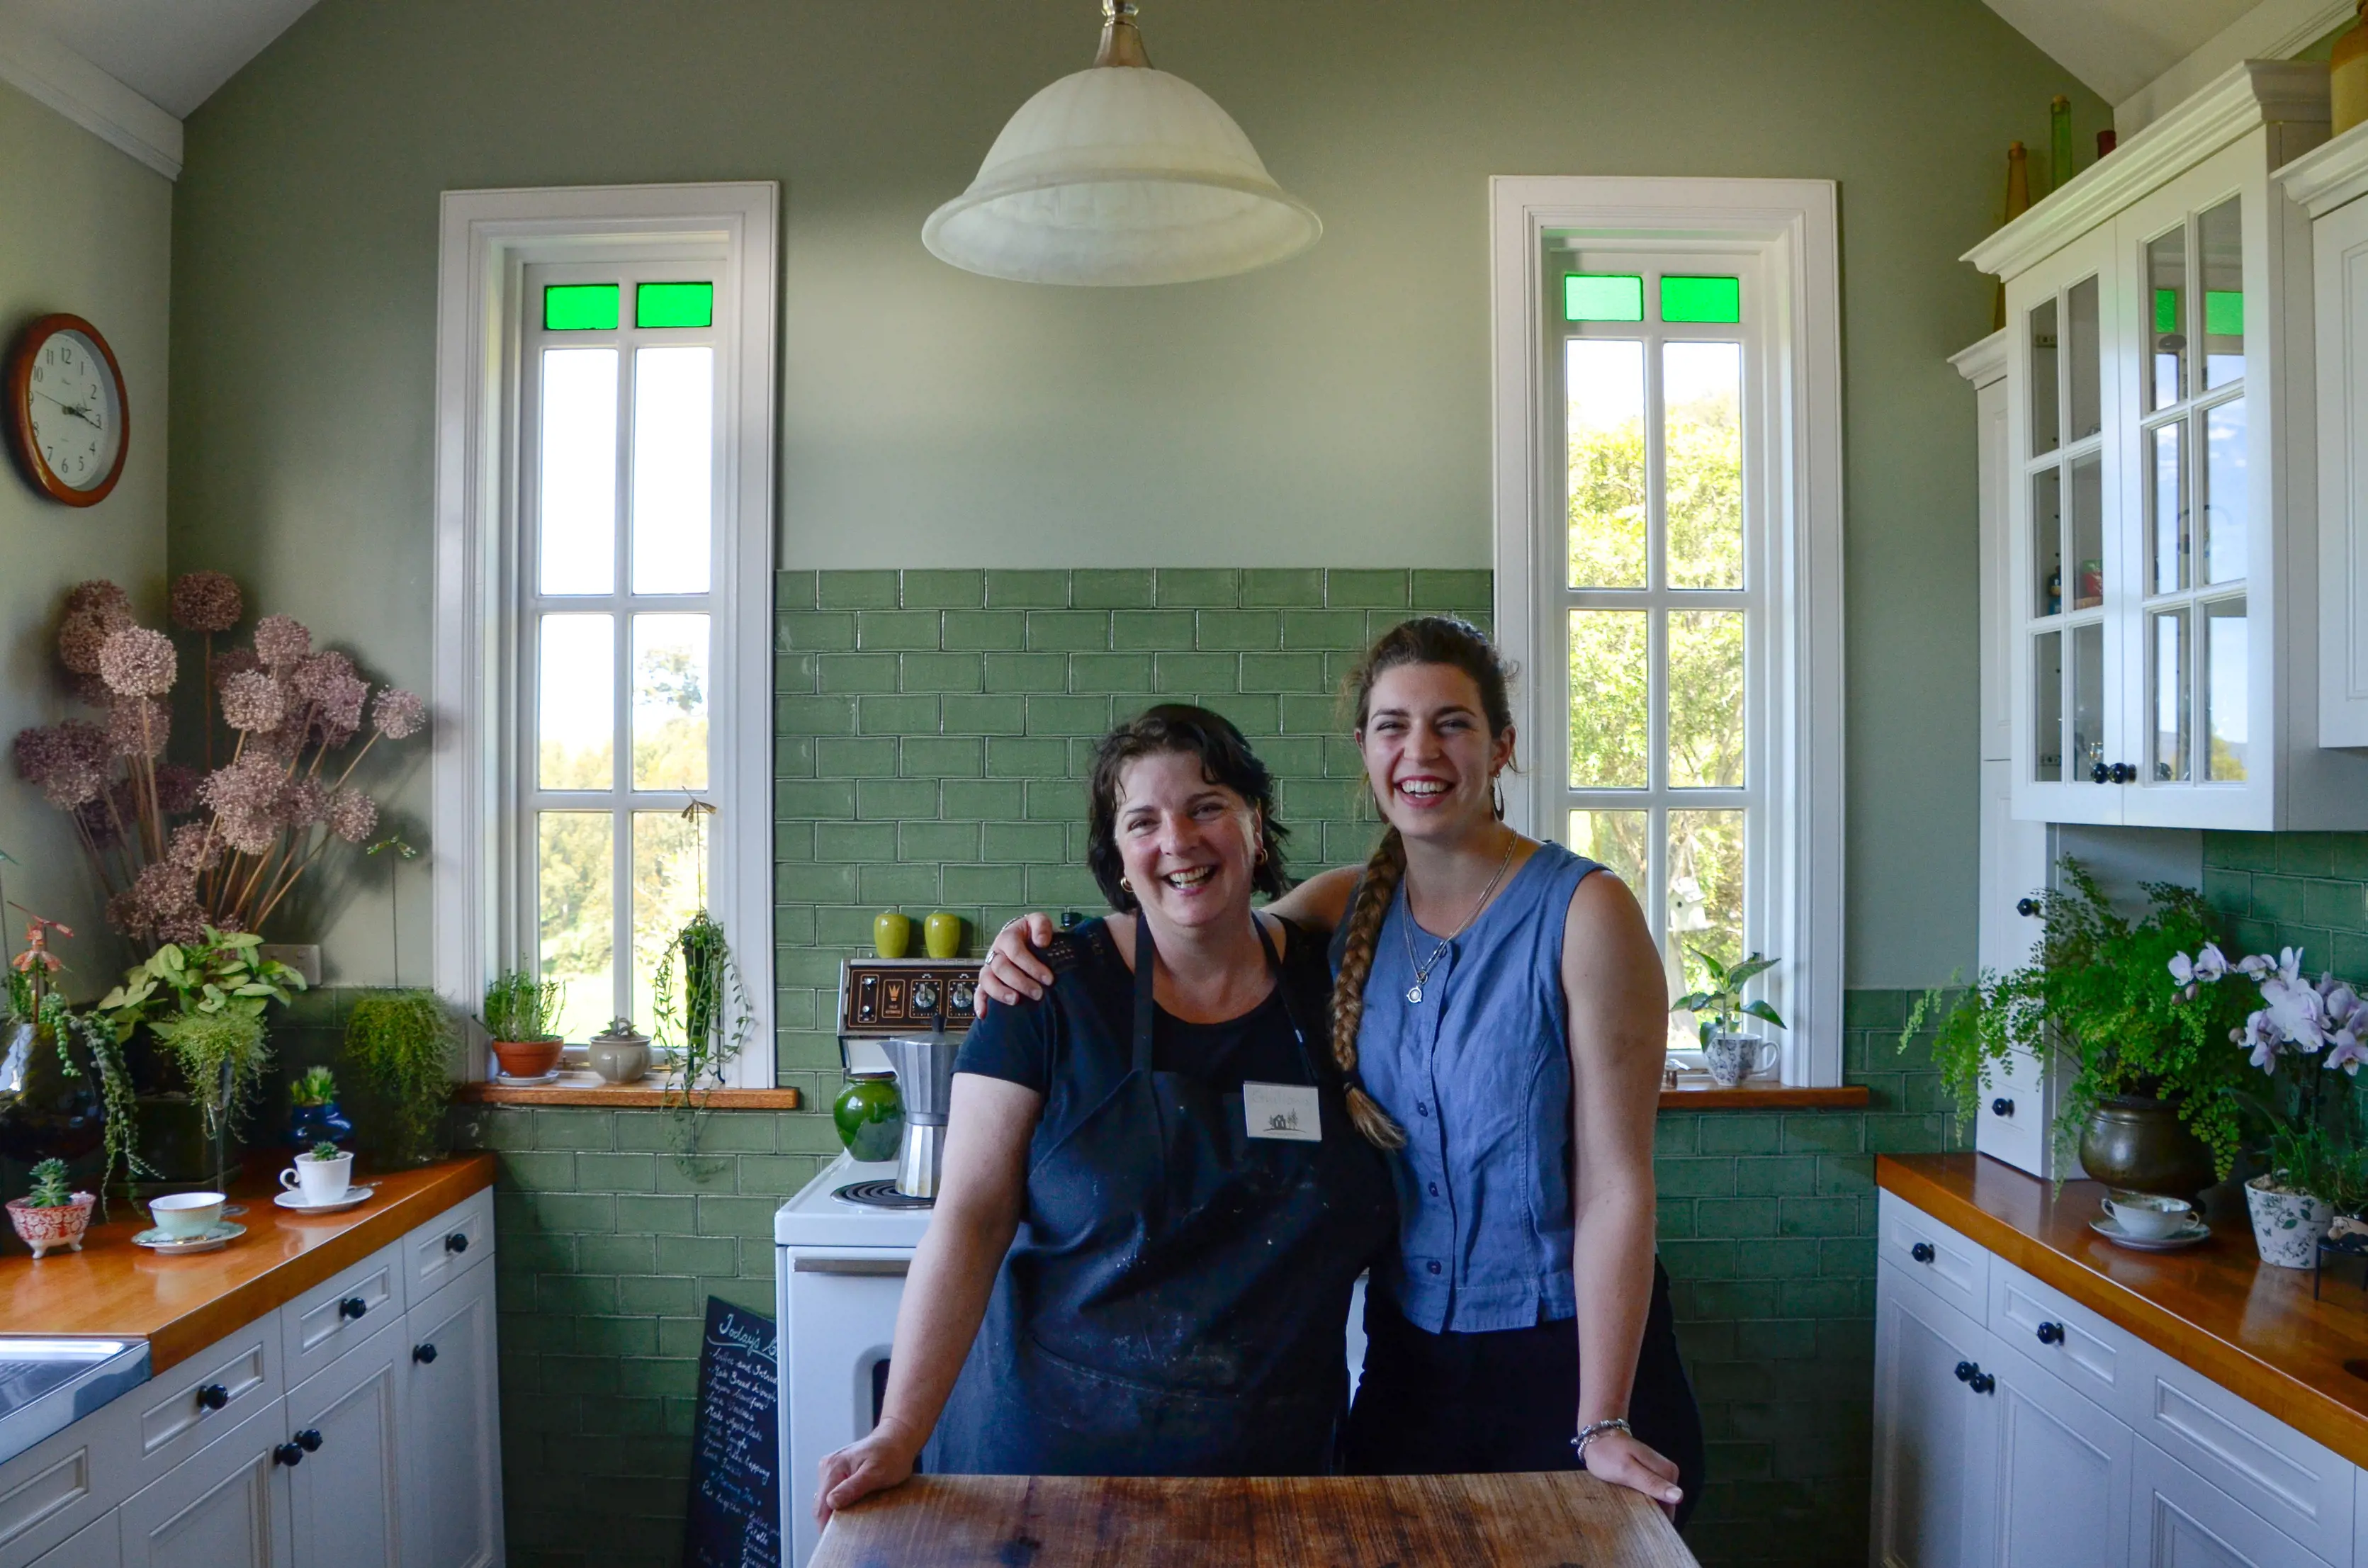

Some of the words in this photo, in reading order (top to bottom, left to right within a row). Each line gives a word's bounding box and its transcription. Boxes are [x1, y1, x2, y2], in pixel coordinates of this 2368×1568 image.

[46, 349, 54, 366] 11
[61, 348, 72, 365] 12
[34, 366, 43, 383] 10
[80, 361, 84, 376] 1
[91, 384, 96, 400] 2
[96, 414, 101, 429] 3
[33, 422, 39, 437] 8
[47, 446, 53, 462] 7
[89, 441, 96, 456] 4
[62, 458, 68, 473] 6
[79, 456, 84, 471] 5
[719, 1313, 760, 1357] Today's
[737, 1360, 752, 1373] and
[729, 1371, 751, 1388] Bread
